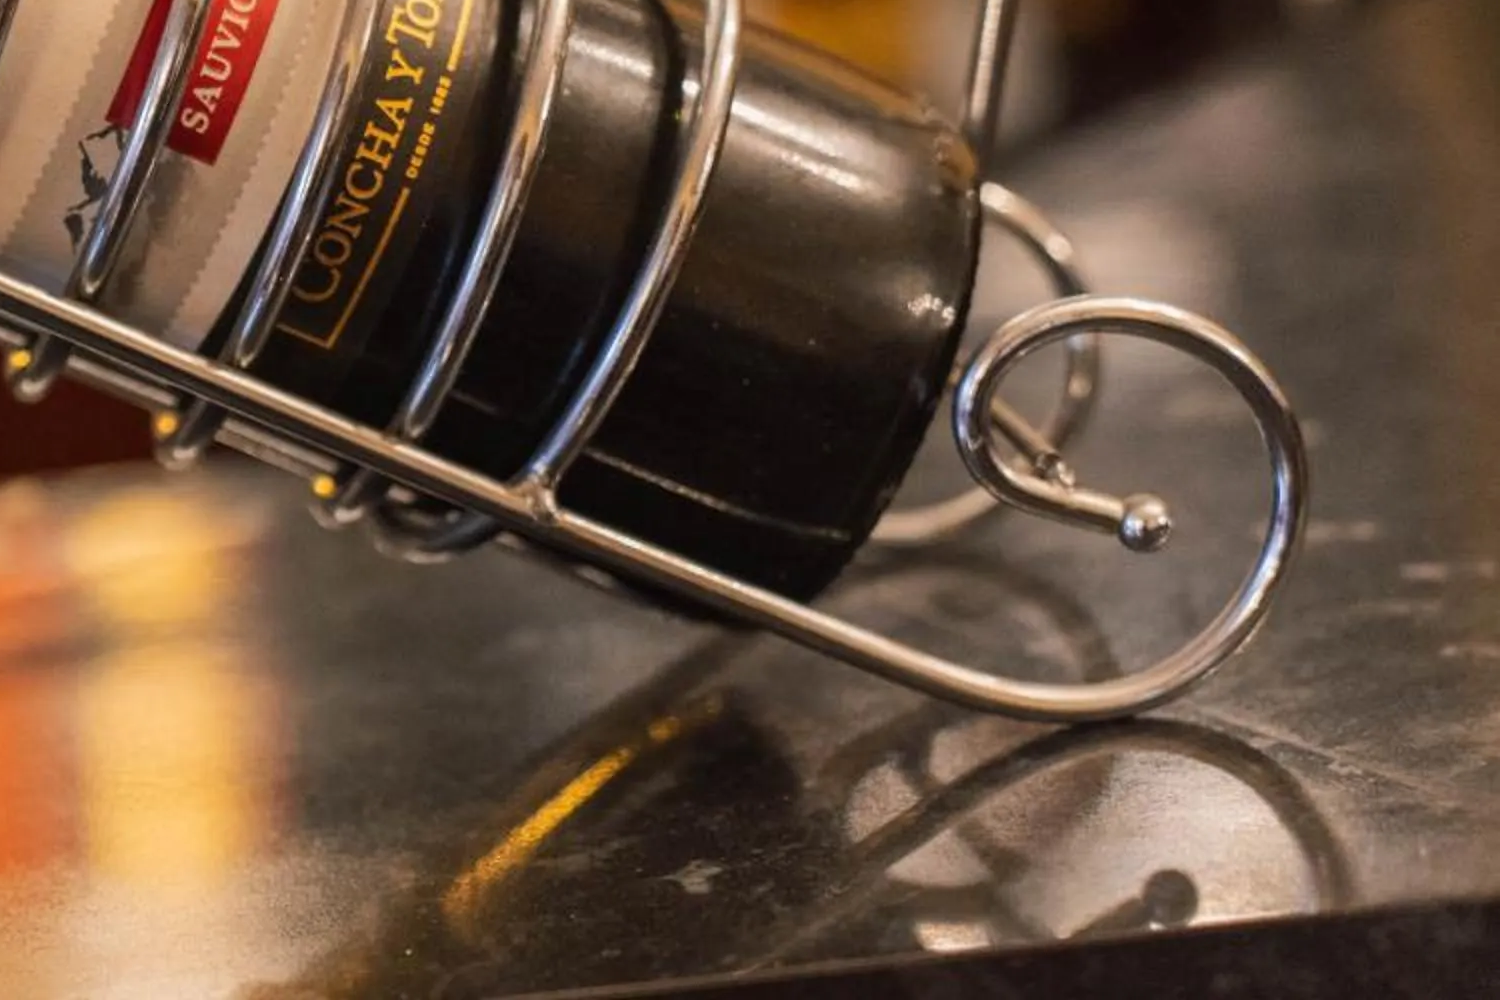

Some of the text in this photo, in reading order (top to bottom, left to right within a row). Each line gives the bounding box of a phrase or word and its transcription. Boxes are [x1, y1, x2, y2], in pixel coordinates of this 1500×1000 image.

[293, 96, 414, 304] CONCHA
[385, 50, 425, 86] Y
[406, 121, 436, 180] DESDE
